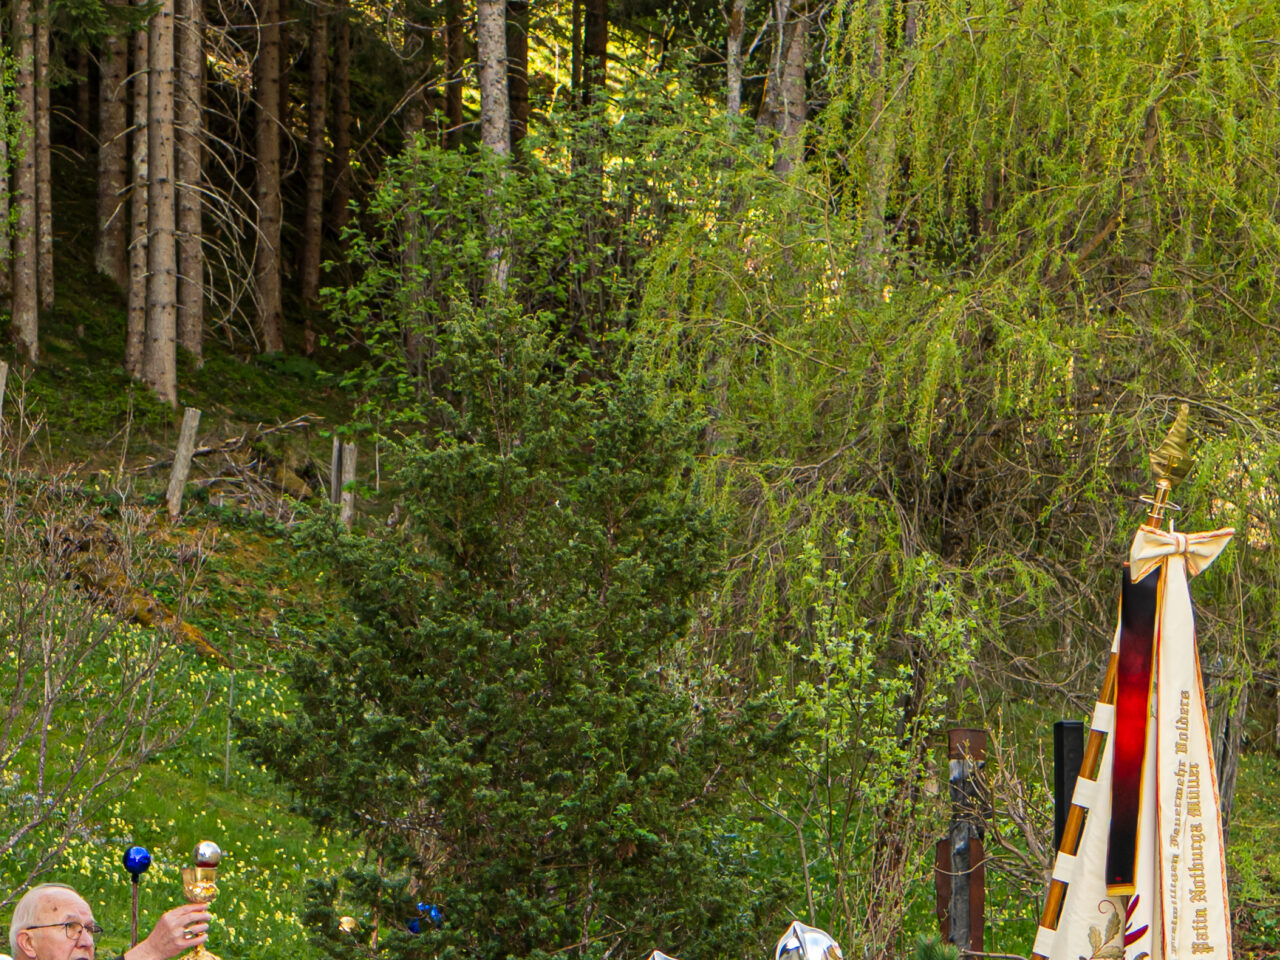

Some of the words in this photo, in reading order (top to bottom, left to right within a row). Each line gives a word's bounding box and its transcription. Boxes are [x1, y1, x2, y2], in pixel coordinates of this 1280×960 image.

[1187, 762, 1201, 818] Müller
[1188, 822, 1207, 903] Notburga
[1191, 907, 1214, 955] Patin
